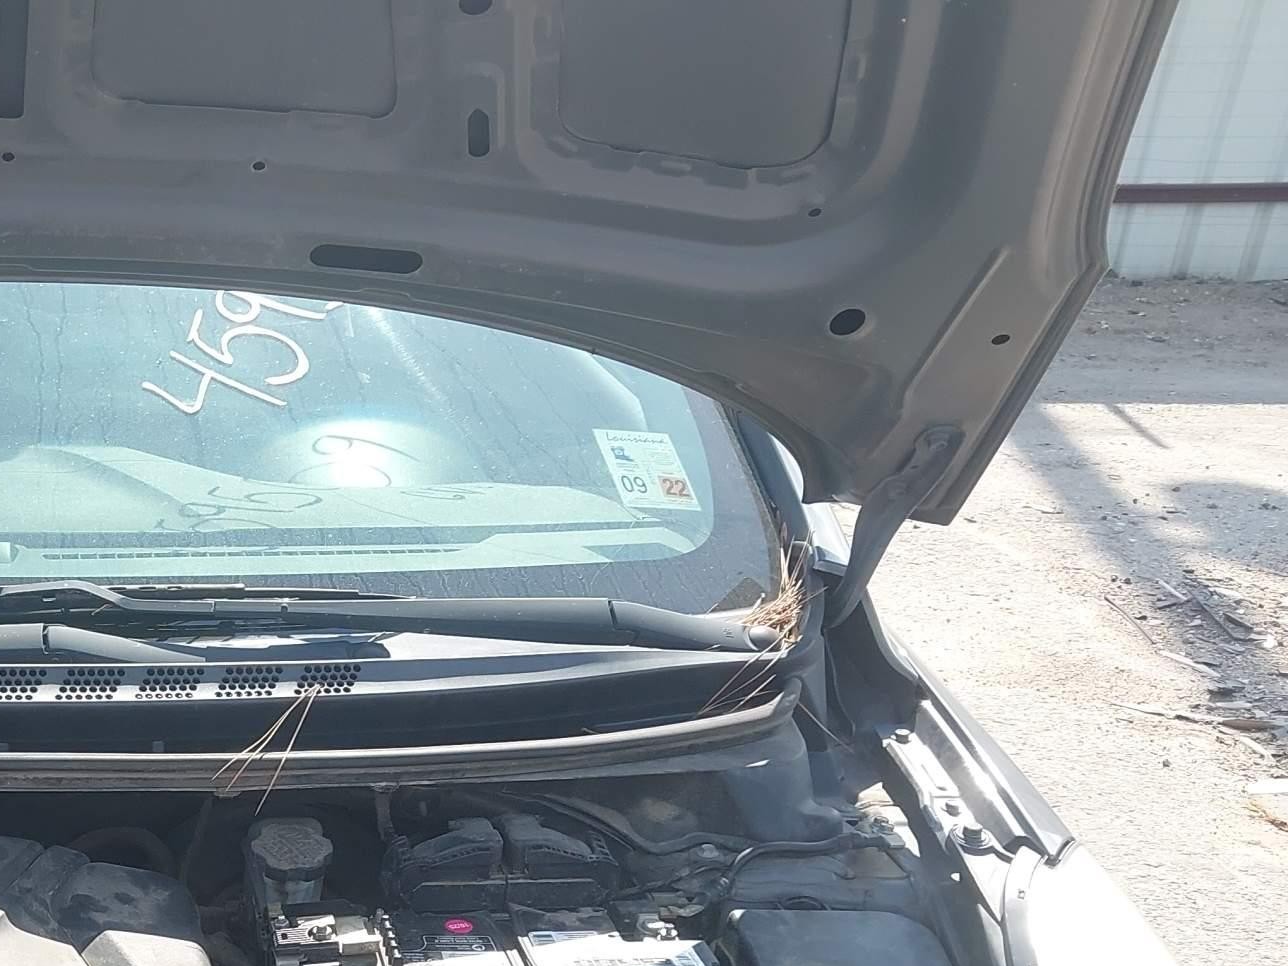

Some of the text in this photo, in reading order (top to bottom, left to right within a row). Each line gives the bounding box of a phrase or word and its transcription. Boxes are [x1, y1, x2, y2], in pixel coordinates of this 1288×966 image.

[142, 290, 344, 414] 459
[605, 431, 665, 444] Louisiana
[620, 475, 691, 498] 09 22
